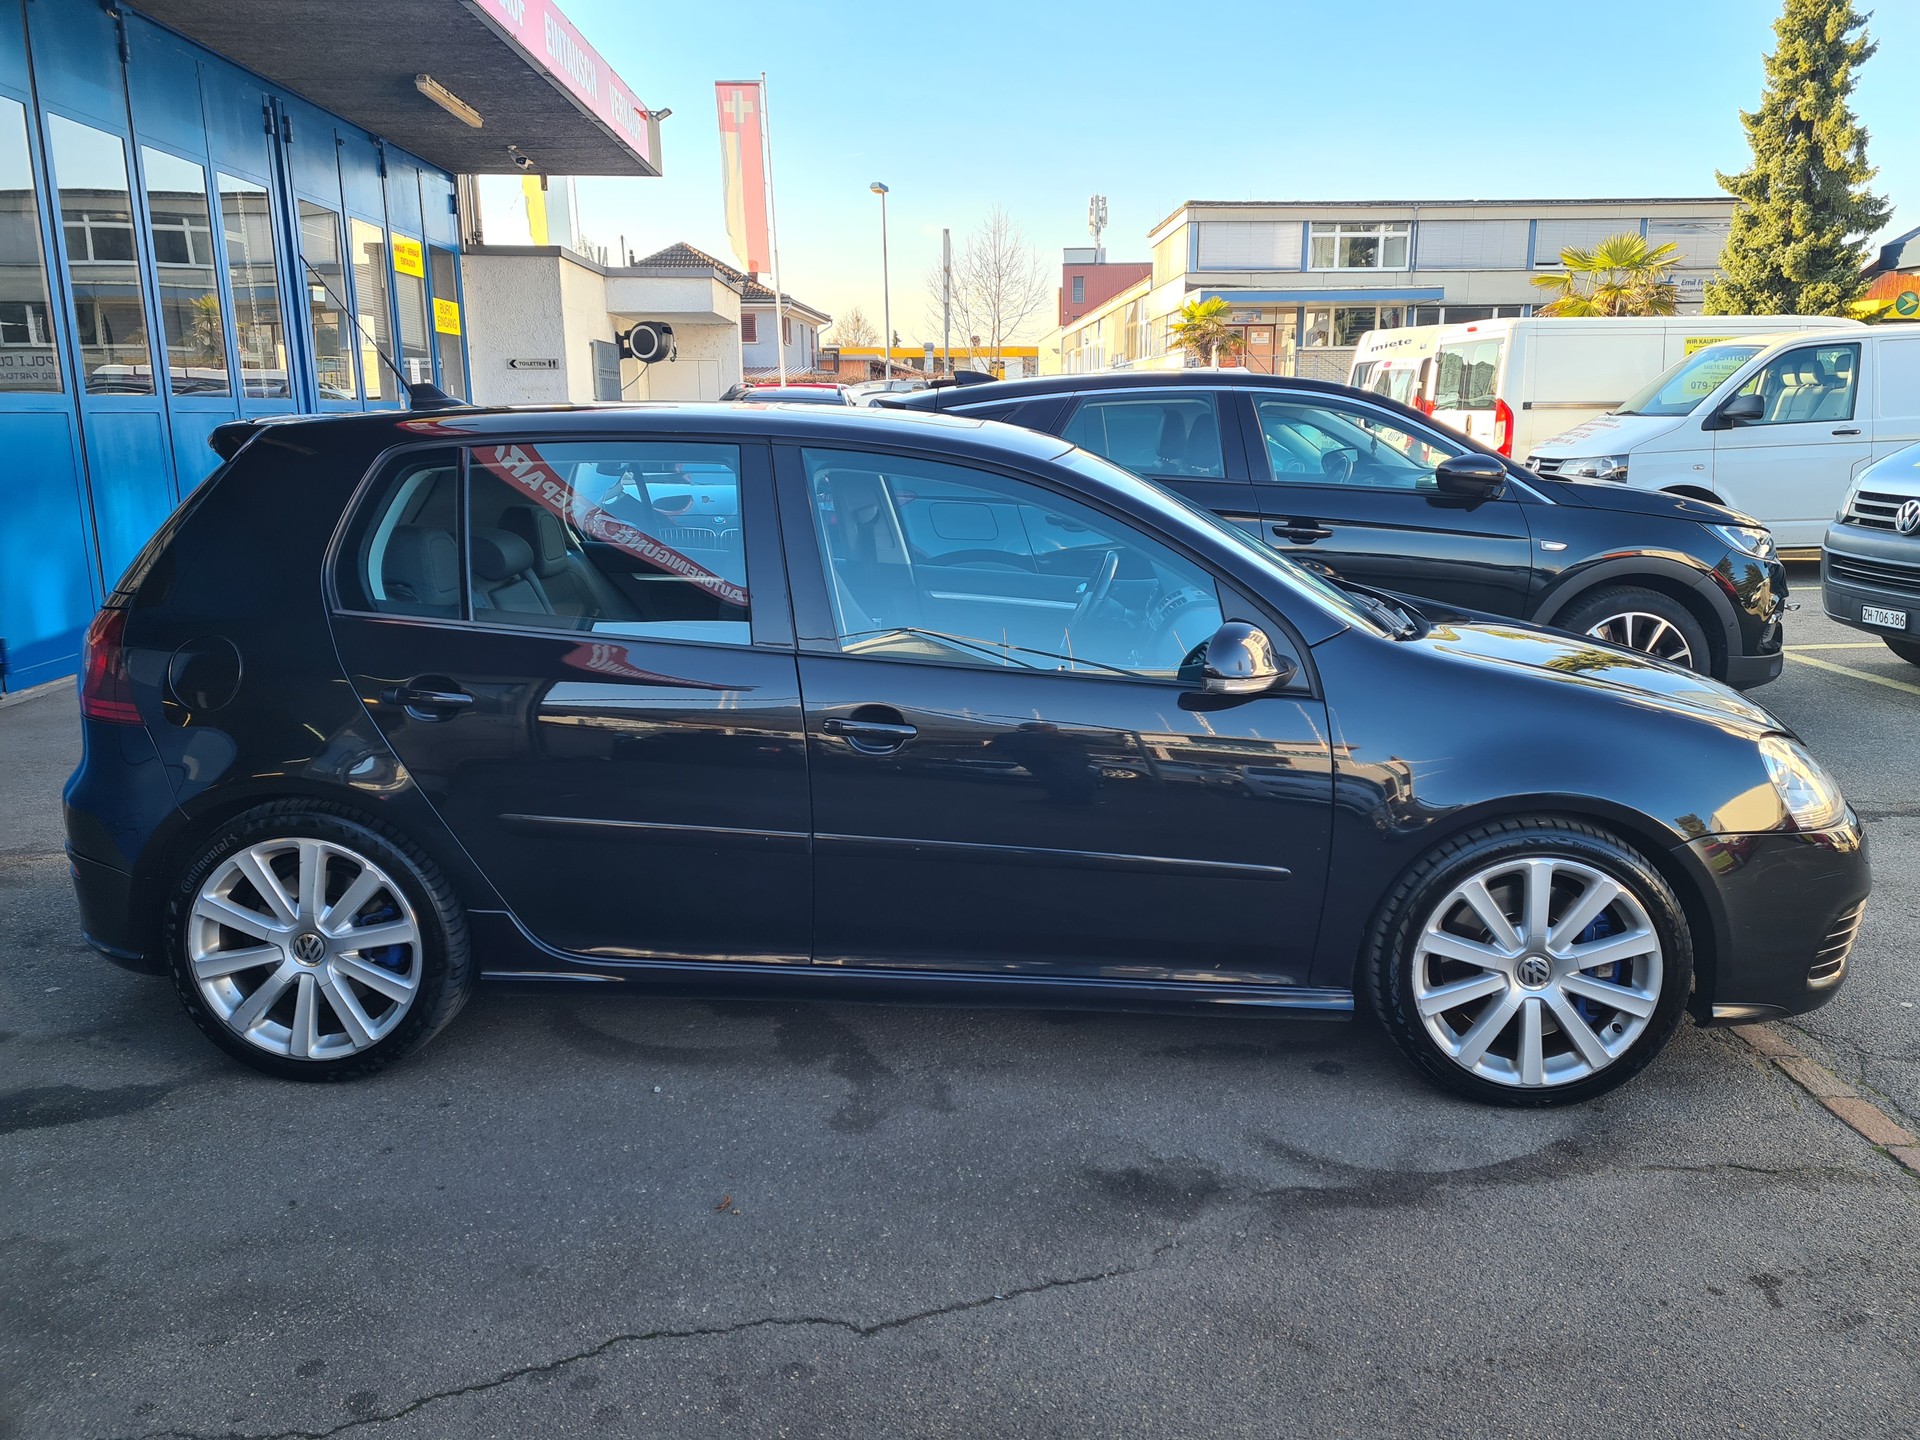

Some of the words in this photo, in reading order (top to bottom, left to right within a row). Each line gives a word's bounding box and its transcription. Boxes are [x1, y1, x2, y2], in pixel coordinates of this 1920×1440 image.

[544, 10, 598, 101] EINTAUSCH
[608, 81, 642, 142] VERKAUF
[437, 315, 458, 330] EINGANG
[1371, 337, 1413, 352] miete
[180, 836, 232, 894] Continental
